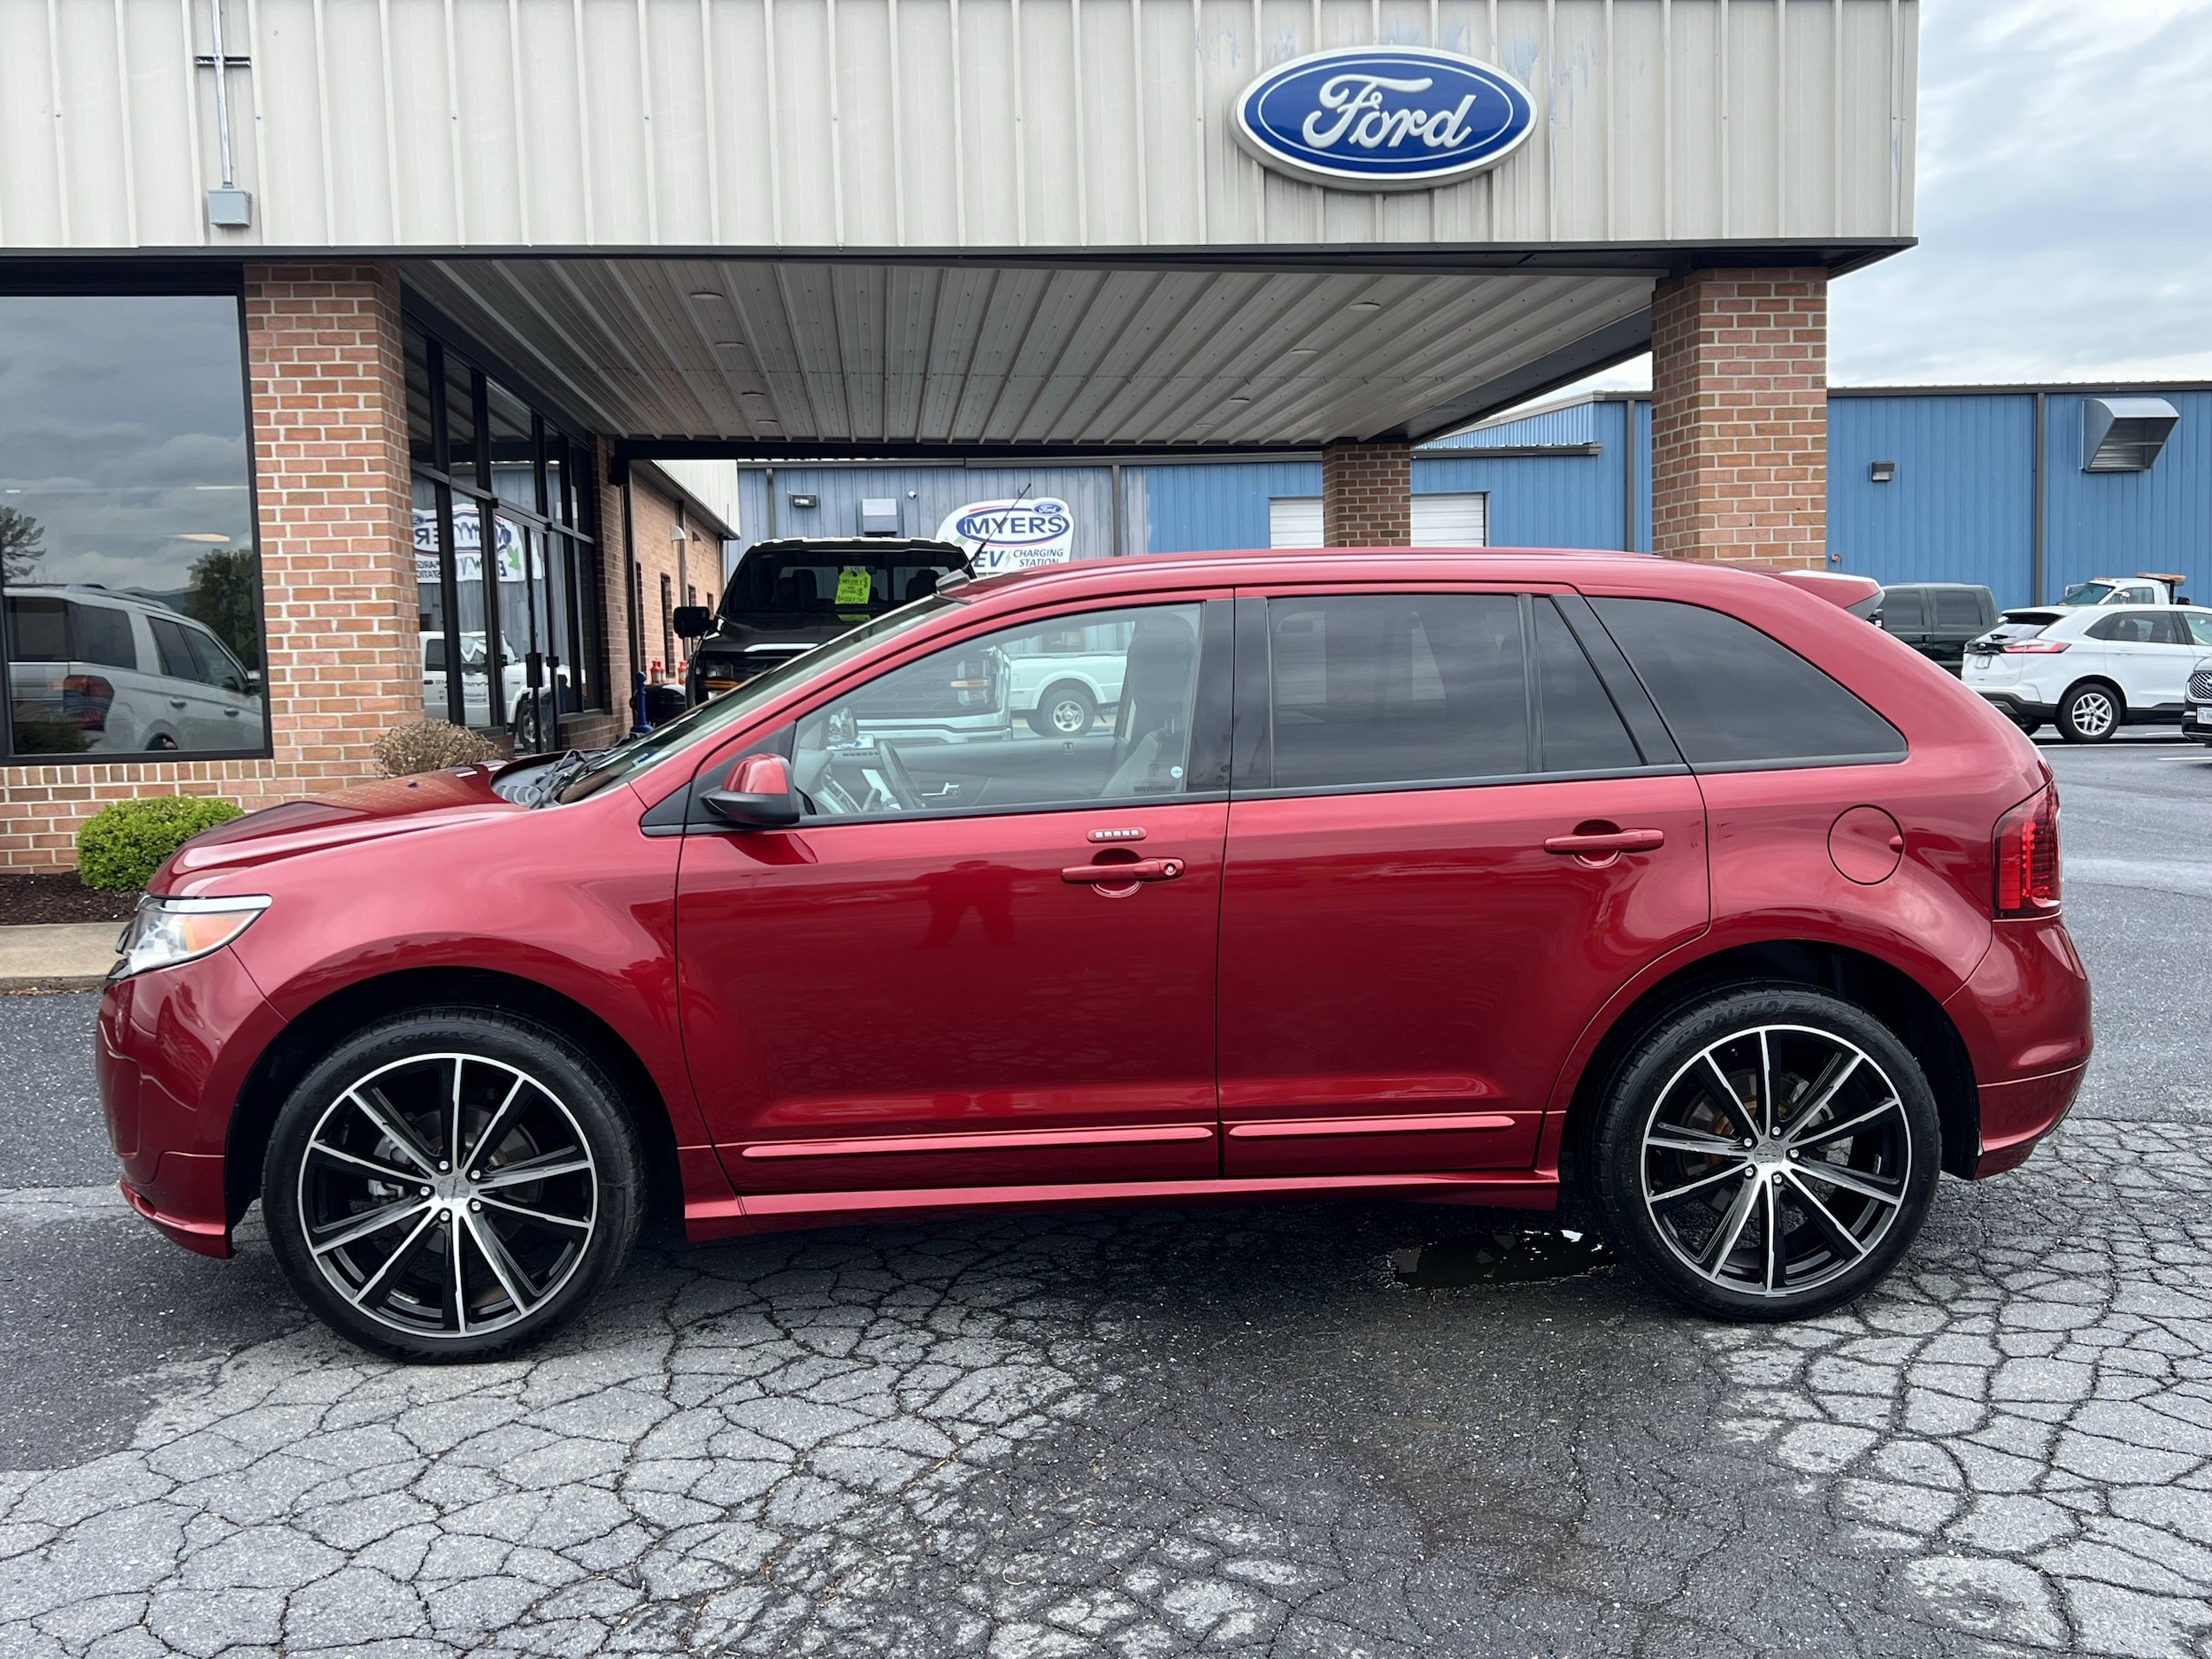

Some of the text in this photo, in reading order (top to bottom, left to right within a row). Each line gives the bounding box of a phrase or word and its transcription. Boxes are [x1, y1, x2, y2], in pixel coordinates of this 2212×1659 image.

[1302, 73, 1477, 149] Ford
[1038, 504, 1057, 514] Ford
[966, 516, 1063, 534] MYERS
[973, 550, 1005, 568] EV
[1013, 549, 1064, 557] CHARGING
[1019, 558, 1059, 567] STATION
